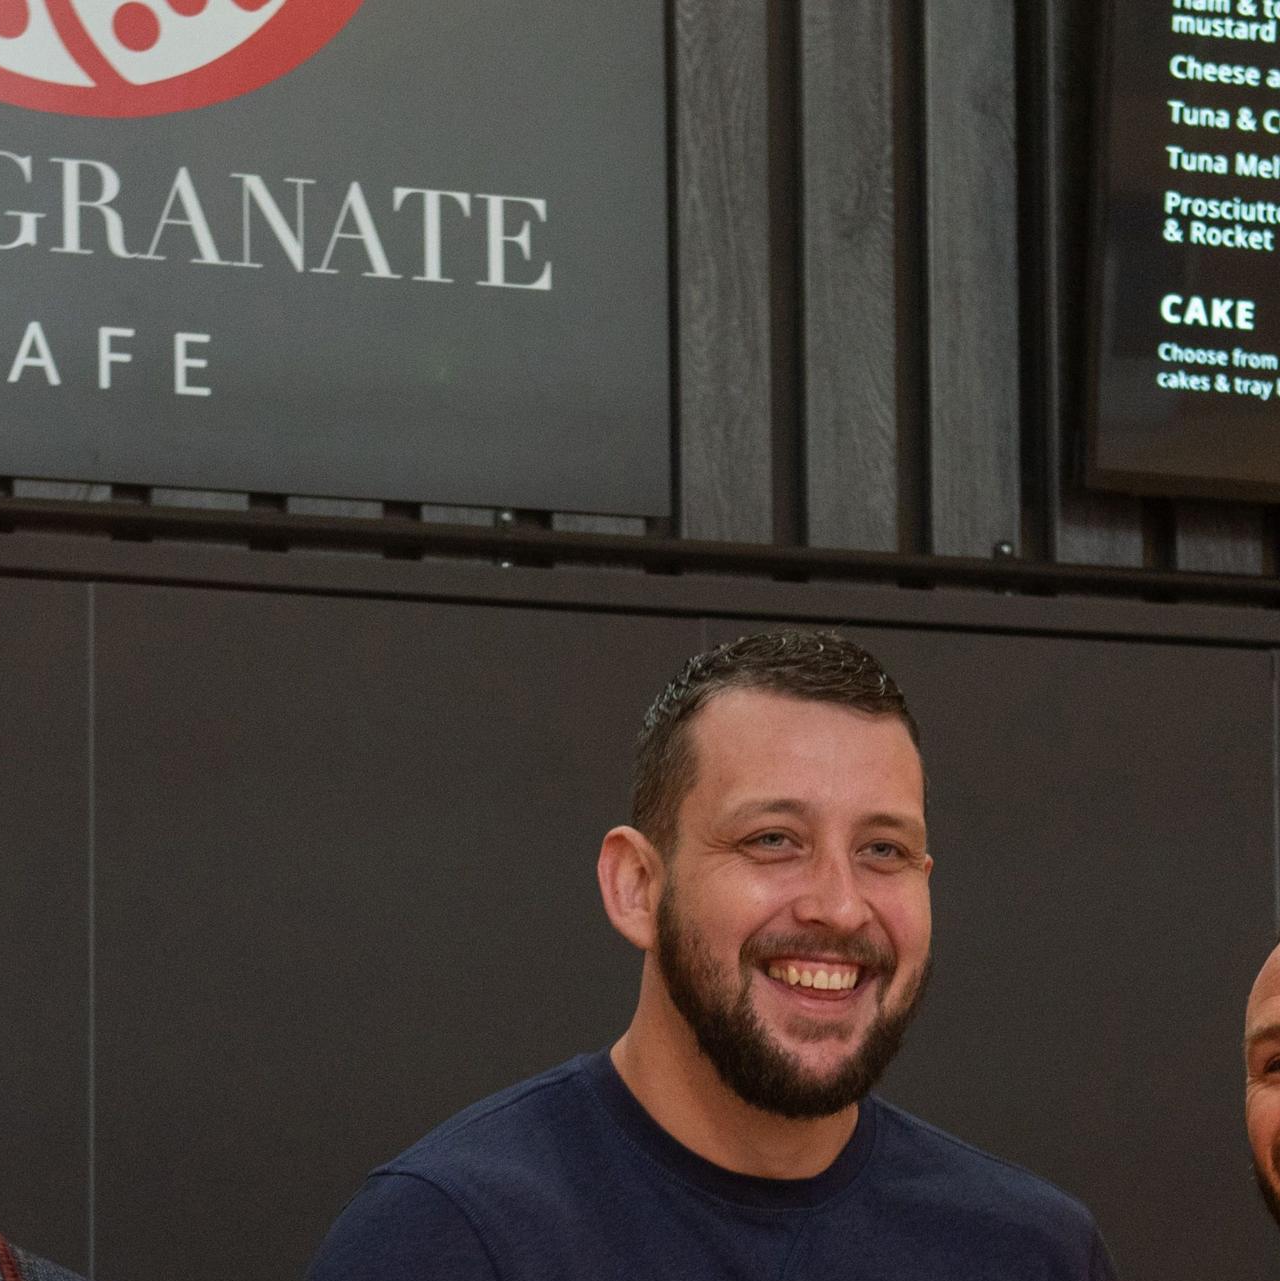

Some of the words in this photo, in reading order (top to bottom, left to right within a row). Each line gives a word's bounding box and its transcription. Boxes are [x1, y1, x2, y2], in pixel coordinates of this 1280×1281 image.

[1237, 0, 1257, 16] &
[1172, 15, 1276, 42] mustard
[1170, 55, 1260, 86] Cheese
[1168, 101, 1229, 128] Tuna
[1237, 107, 1256, 131] &
[1166, 146, 1228, 174] Tuna
[1163, 219, 1183, 242] &
[1190, 221, 1274, 251] Rocket
[1161, 295, 1254, 330] CAKE
[1158, 343, 1228, 366] Choose
[1232, 348, 1278, 370] from
[1157, 371, 1210, 391] cakes
[1214, 374, 1230, 392] &
[1234, 378, 1273, 400] tray
